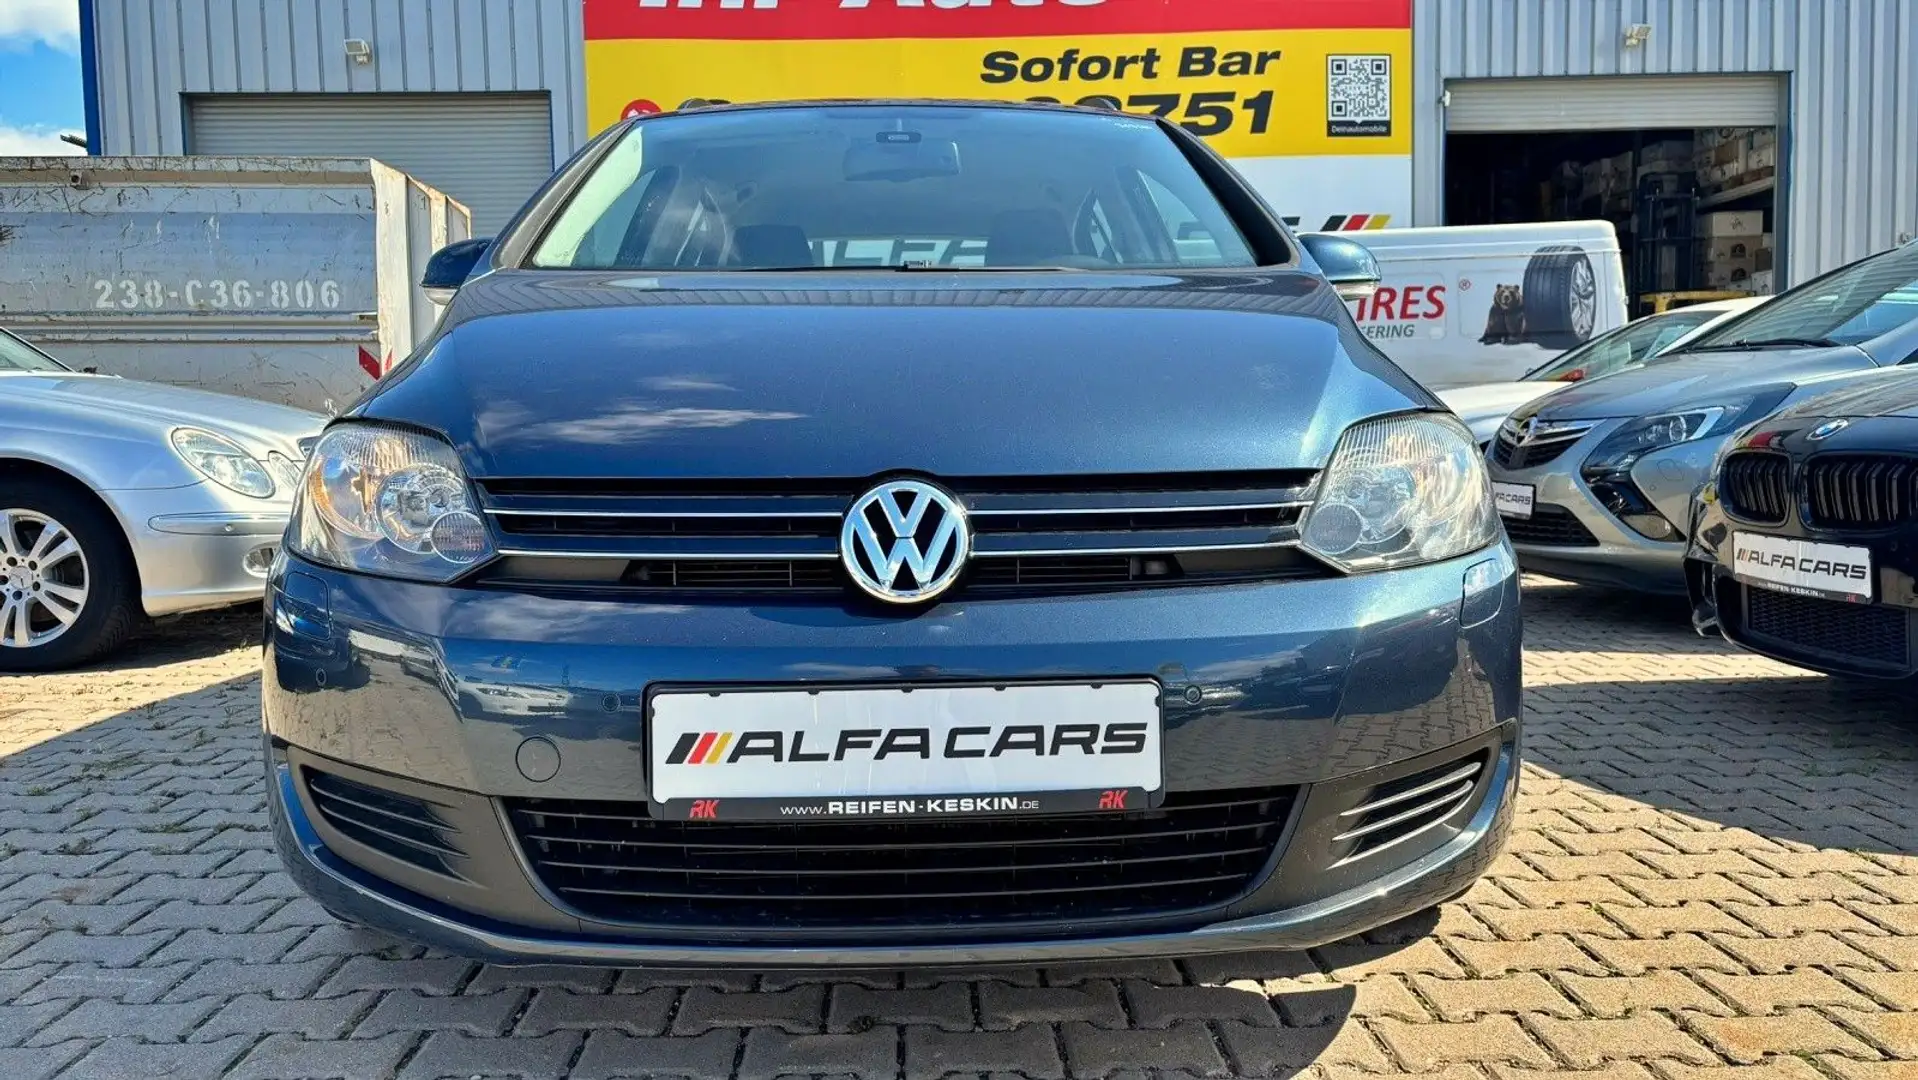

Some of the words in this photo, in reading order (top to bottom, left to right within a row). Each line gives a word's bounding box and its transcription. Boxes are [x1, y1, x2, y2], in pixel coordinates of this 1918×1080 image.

[980, 48, 1161, 84] Sofort
[1177, 46, 1282, 78] Bar
[93, 279, 341, 309] 238-C36-806
[1356, 285, 1446, 322] IRES
[1748, 550, 1796, 571] ALFA
[1798, 558, 1867, 580] CARS
[726, 728, 930, 764] ALFA
[943, 722, 1148, 759] CARS
[689, 800, 720, 818] RK
[1099, 789, 1128, 809] RK
